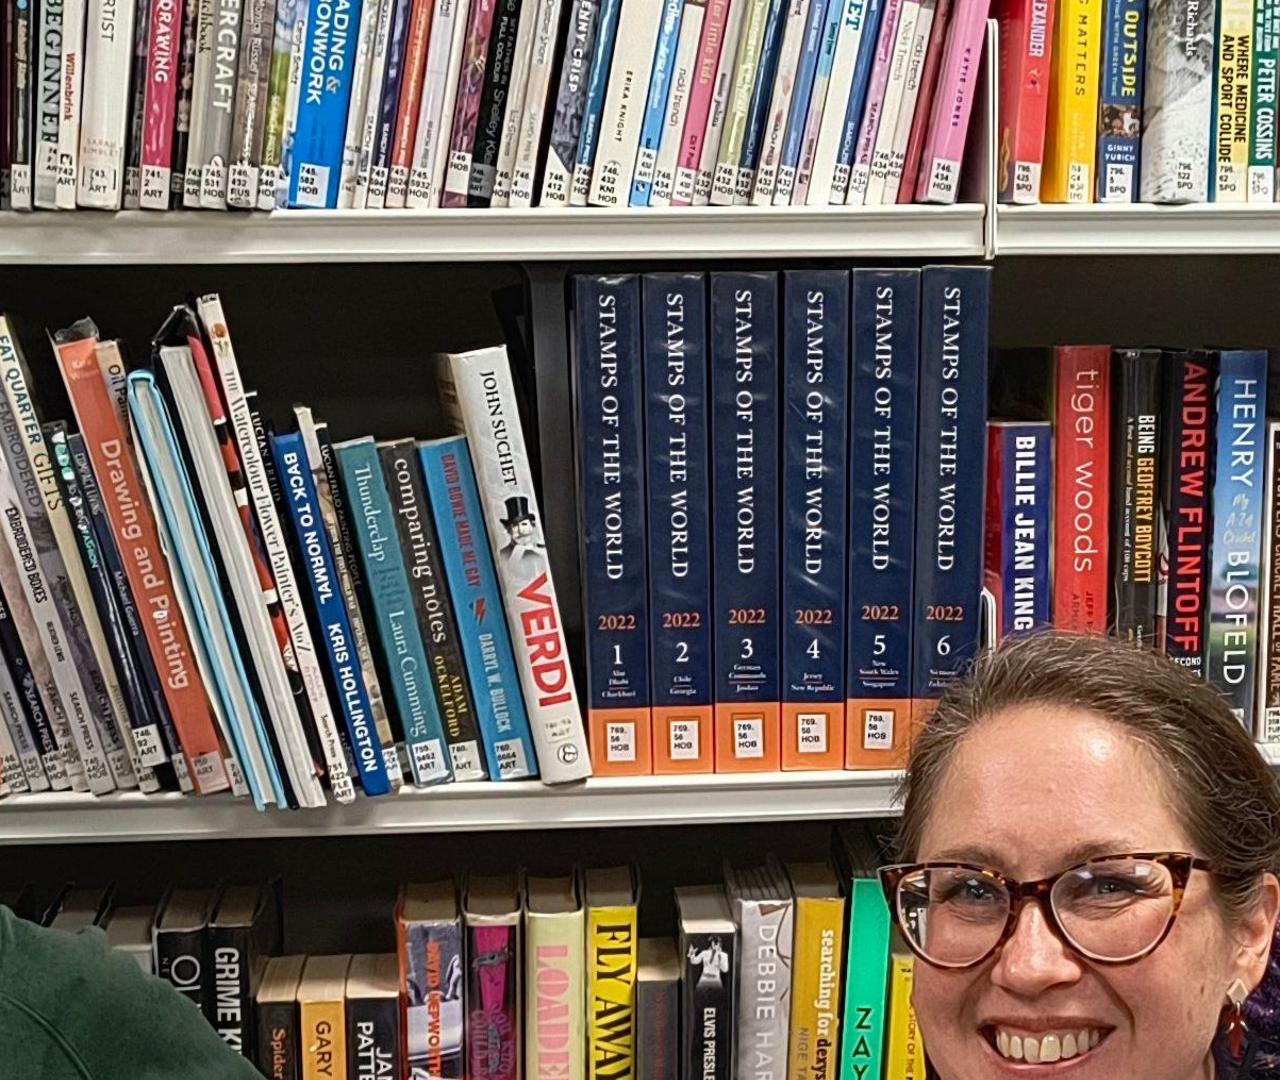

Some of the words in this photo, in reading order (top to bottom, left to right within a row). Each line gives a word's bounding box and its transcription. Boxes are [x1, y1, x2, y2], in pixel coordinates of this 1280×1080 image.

[961, 48, 972, 84] KATIE
[1221, 36, 1234, 62] AND
[1236, 35, 1249, 81] WHERE
[623, 70, 634, 100] ERIKA
[1221, 67, 1233, 109] SPORT
[1257, 59, 1276, 103] PETER
[615, 103, 627, 144] KNIGHT
[951, 89, 963, 128] JONES
[1235, 83, 1248, 144] MEDICINE
[1256, 104, 1275, 159] COSSINS
[1219, 113, 1231, 163] COLLIDE
[599, 295, 618, 388] STAMPS
[667, 293, 685, 387] STAMPS
[736, 290, 753, 383] STAMPS
[807, 291, 824, 384] STAMPS
[876, 287, 893, 380] STAMPS
[943, 287, 961, 380] STAMPS
[480, 370, 504, 418] JOHN
[493, 420, 517, 486] SUCHET
[601, 397, 619, 426] OF
[668, 394, 686, 426] OF
[736, 391, 753, 422] OF
[806, 392, 823, 422] OF
[875, 388, 892, 419] OF
[942, 388, 959, 419] OF
[1071, 370, 1099, 449] tiger
[874, 426, 891, 476] THE
[940, 426, 958, 476] THE
[1181, 360, 1208, 498] ANDREW
[1230, 379, 1258, 487] HENRY
[604, 434, 620, 484] THE
[669, 433, 687, 483] THE
[736, 430, 754, 479] THE
[806, 431, 823, 479] THE
[1015, 436, 1035, 504] BILLIE
[604, 491, 624, 580] WORLD
[670, 489, 689, 578] WORLD
[736, 485, 755, 575] WORLD
[805, 487, 823, 575] WORLD
[872, 483, 890, 571] WORLD
[938, 483, 956, 571] WORLD
[1015, 512, 1035, 572] JEAN
[1074, 462, 1099, 573] woods
[99, 439, 143, 541] Drawing
[134, 547, 165, 590] and
[150, 593, 190, 690] Painting
[394, 457, 432, 578] comparing
[423, 577, 447, 644] notes
[1174, 504, 1205, 652] FLINTOFF
[597, 614, 636, 630] 2022
[663, 612, 702, 629] 2022
[728, 608, 766, 624] 2022
[794, 609, 832, 624] 2022
[861, 605, 900, 621] 2022
[925, 605, 964, 622] 2022
[1014, 579, 1034, 631] KING
[1222, 552, 1250, 685] BLOFELD
[518, 572, 572, 707] VERDI
[613, 644, 623, 665] 1
[675, 643, 690, 663] 2
[741, 638, 754, 659] 3
[806, 638, 821, 659] 4
[872, 634, 886, 656] 5
[937, 634, 952, 656] 6
[328, 622, 350, 661] KRIS
[339, 663, 378, 774] HOLLINGTON
[595, 922, 633, 986] FLY
[704, 1007, 716, 1039] ELVIS
[315, 1020, 333, 1077] GARY
